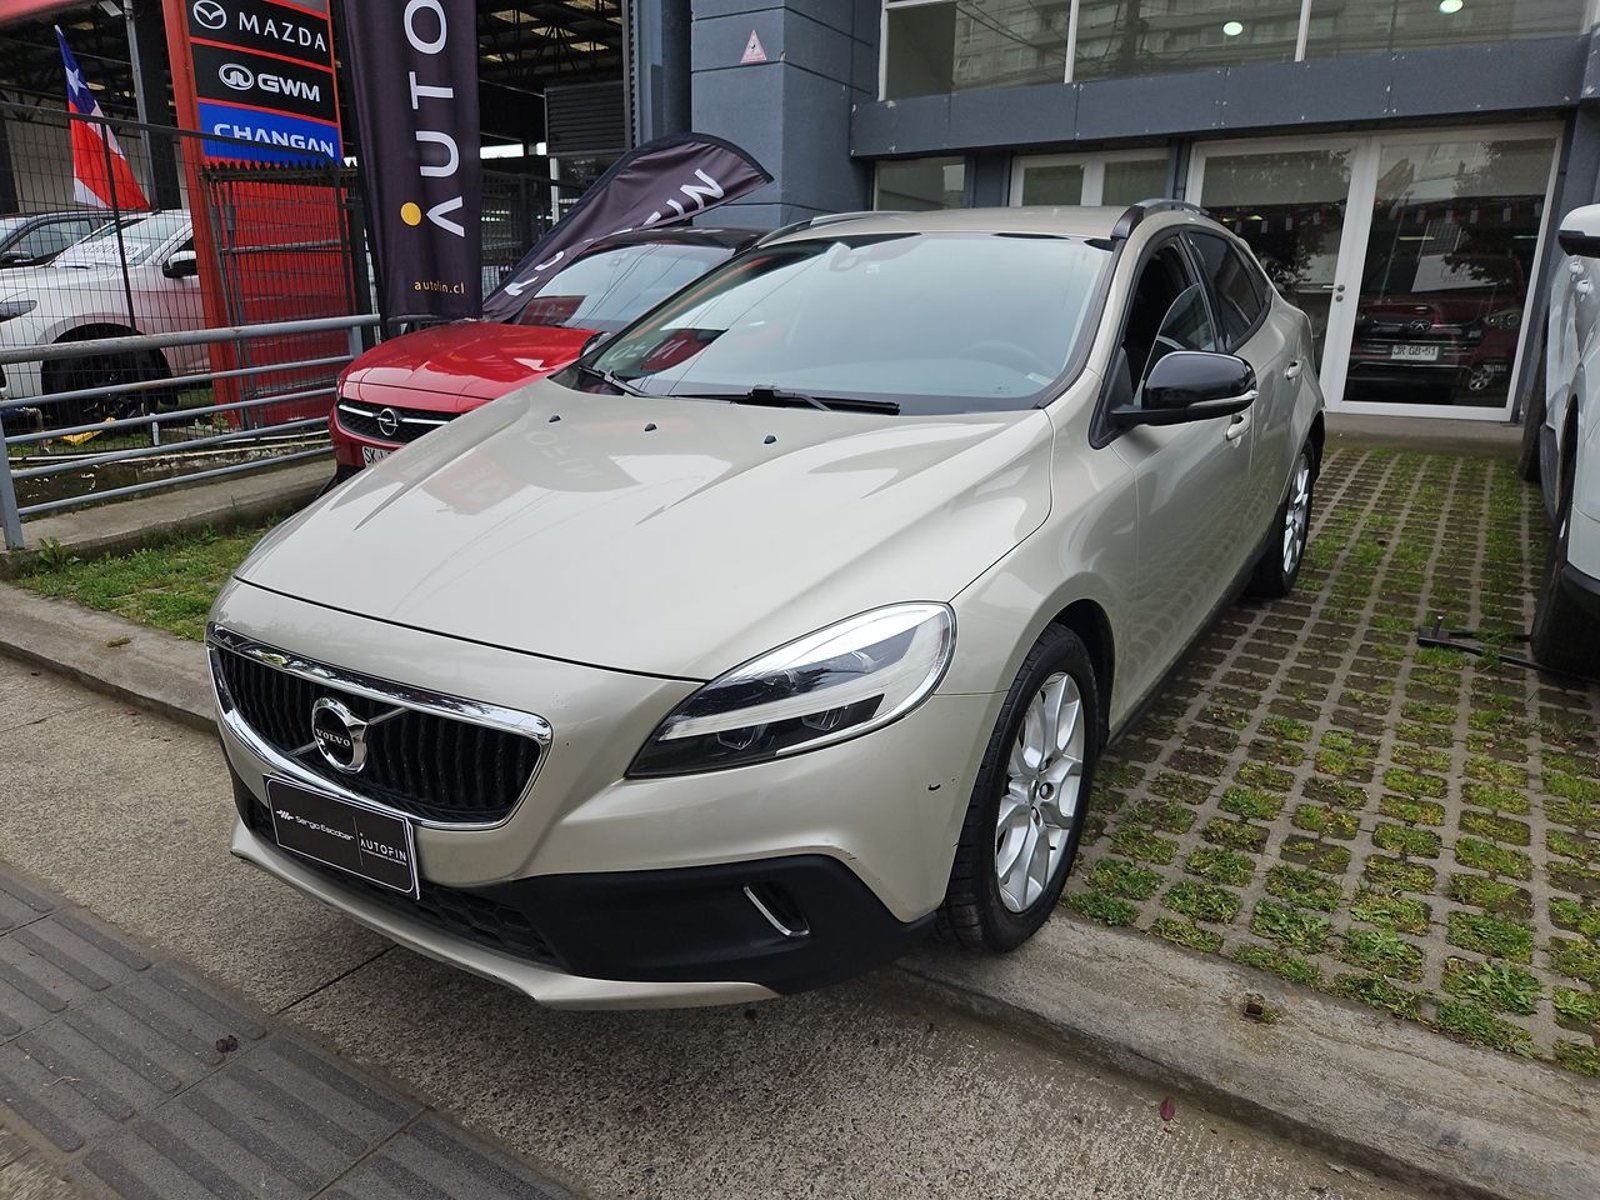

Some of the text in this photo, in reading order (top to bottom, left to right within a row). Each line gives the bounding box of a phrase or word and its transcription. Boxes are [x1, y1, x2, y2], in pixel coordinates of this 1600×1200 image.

[239, 11, 327, 52] MAZDA
[257, 73, 321, 102] GWM
[402, 0, 465, 238] AUTO
[214, 123, 335, 158] CHANGAN
[315, 728, 351, 747] VOLVO
[360, 837, 407, 862] AUTOFIN
